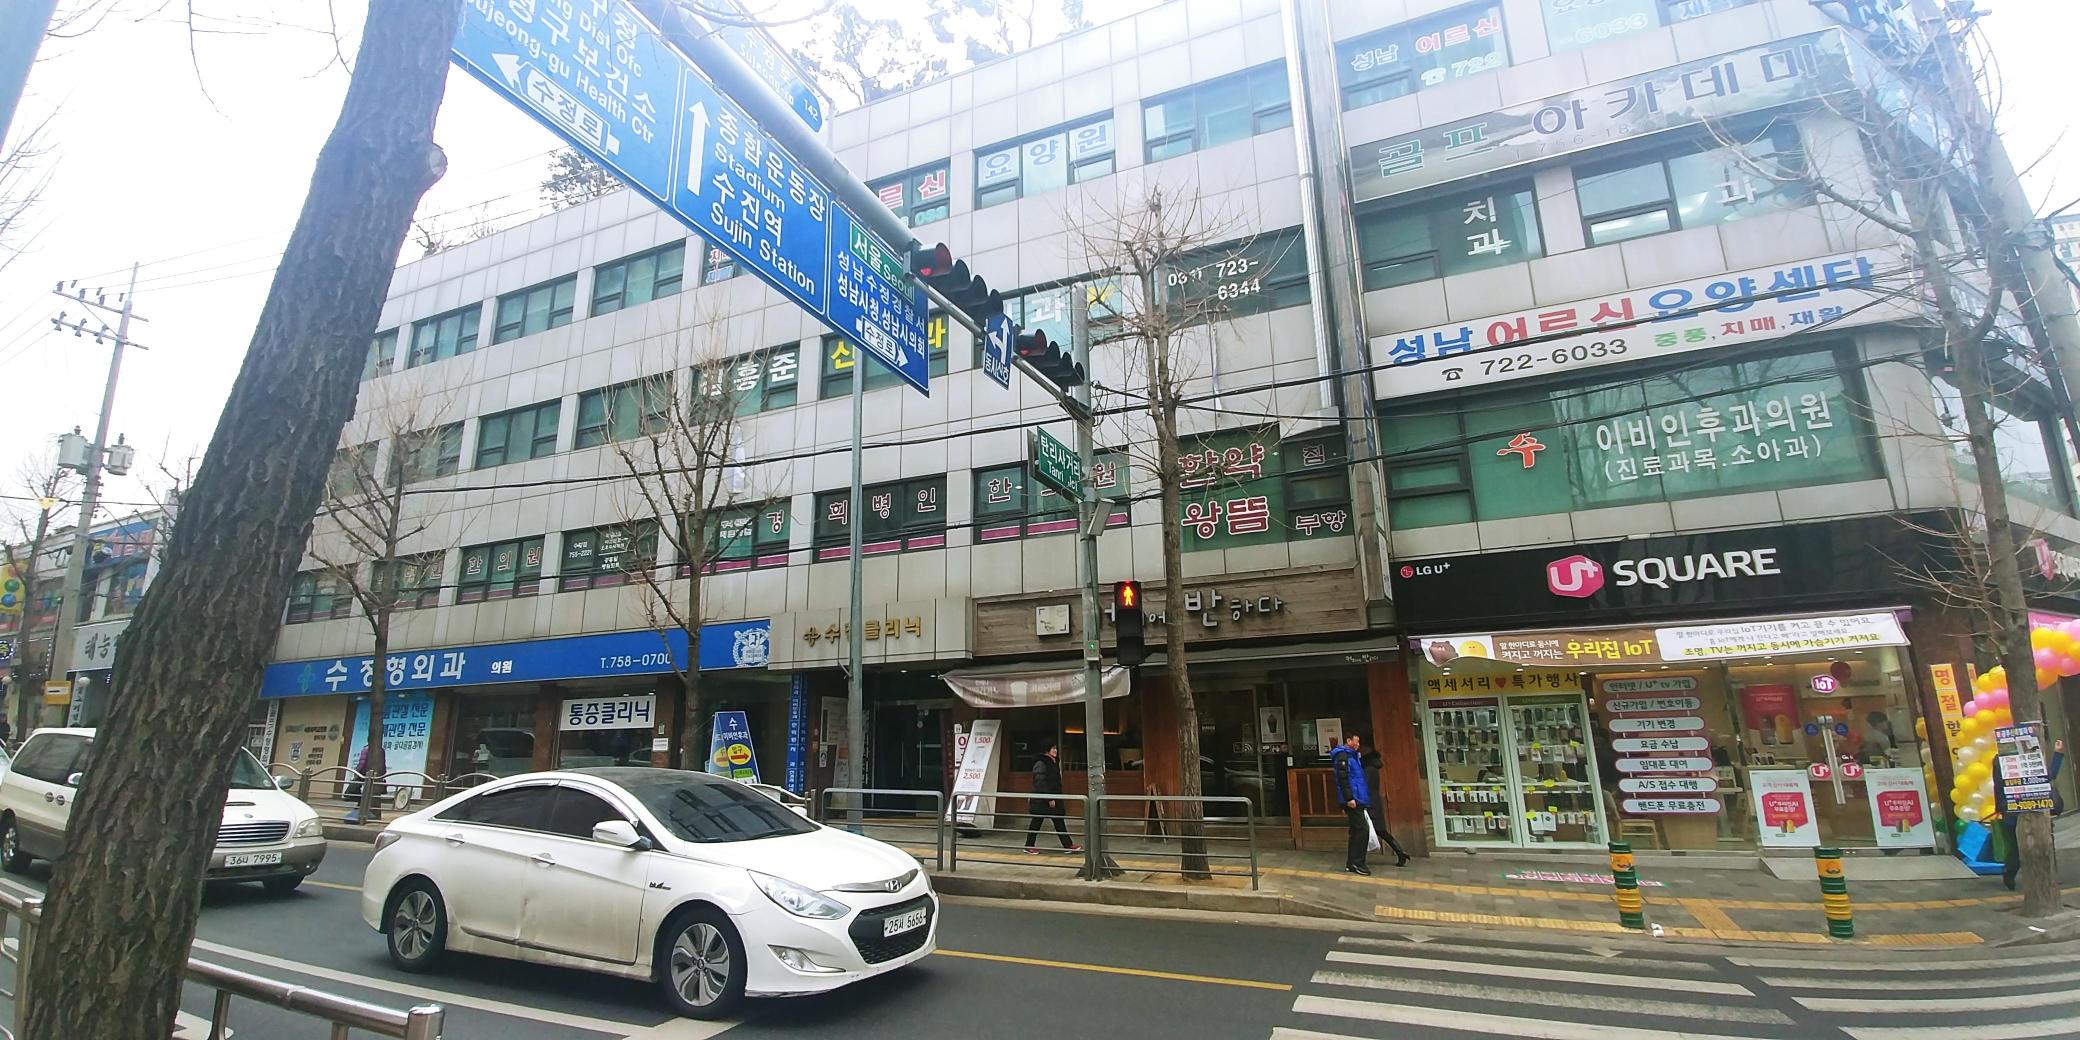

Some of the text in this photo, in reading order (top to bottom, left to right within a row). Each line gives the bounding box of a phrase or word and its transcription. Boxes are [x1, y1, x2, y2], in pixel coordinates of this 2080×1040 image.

[579, 11, 610, 51] Dist
[616, 44, 642, 77] Ofc
[1351, 15, 1499, 72] 성남 어르신
[468, 0, 655, 144] ujeong-gu Health Ctr
[532, 76, 600, 144] 수정로
[804, 99, 818, 120] 142
[1378, 122, 1489, 178] 골프
[1532, 44, 1818, 137] 아카데미
[717, 106, 826, 222] 종합운동장
[983, 124, 1108, 181] 요양원
[715, 142, 786, 213] Stadium
[713, 172, 784, 247] 수진역
[711, 202, 753, 249] Sujin
[760, 239, 815, 296] Station
[854, 230, 915, 302] 서울 Seoul
[1218, 278, 1261, 300] 6344
[865, 325, 896, 362] 수정로
[1387, 326, 1475, 368] 성남
[1486, 297, 1639, 349] 어르신
[1480, 338, 1630, 377] 722-6033
[1596, 391, 1834, 454] 이비인후과의원
[1041, 434, 1080, 477] 탄리사거리
[1047, 460, 1064, 482] Tanri
[1178, 443, 1265, 488] 한약
[1181, 496, 1346, 539] 왕뜸 부항
[468, 547, 541, 575] 한의원
[1416, 561, 1450, 576] LG U+
[1612, 547, 1780, 589] SQUARE
[1184, 589, 1283, 627] 반하다
[1566, 639, 1653, 660] 우리집 IoT
[325, 660, 348, 692] 수
[490, 660, 513, 674] 의원
[1427, 672, 1579, 692] 액세서리 특가행사
[1815, 677, 1833, 690] IoT
[569, 700, 650, 726] 통증클리닉
[729, 717, 738, 730] 수
[1637, 719, 1676, 729] 기기 변경
[1640, 740, 1679, 749] 요금 수납
[1639, 760, 1667, 770] 임대폰
[1638, 781, 1656, 789] A/S
[1658, 780, 1676, 790] 접수
[253, 853, 277, 865] 7995
